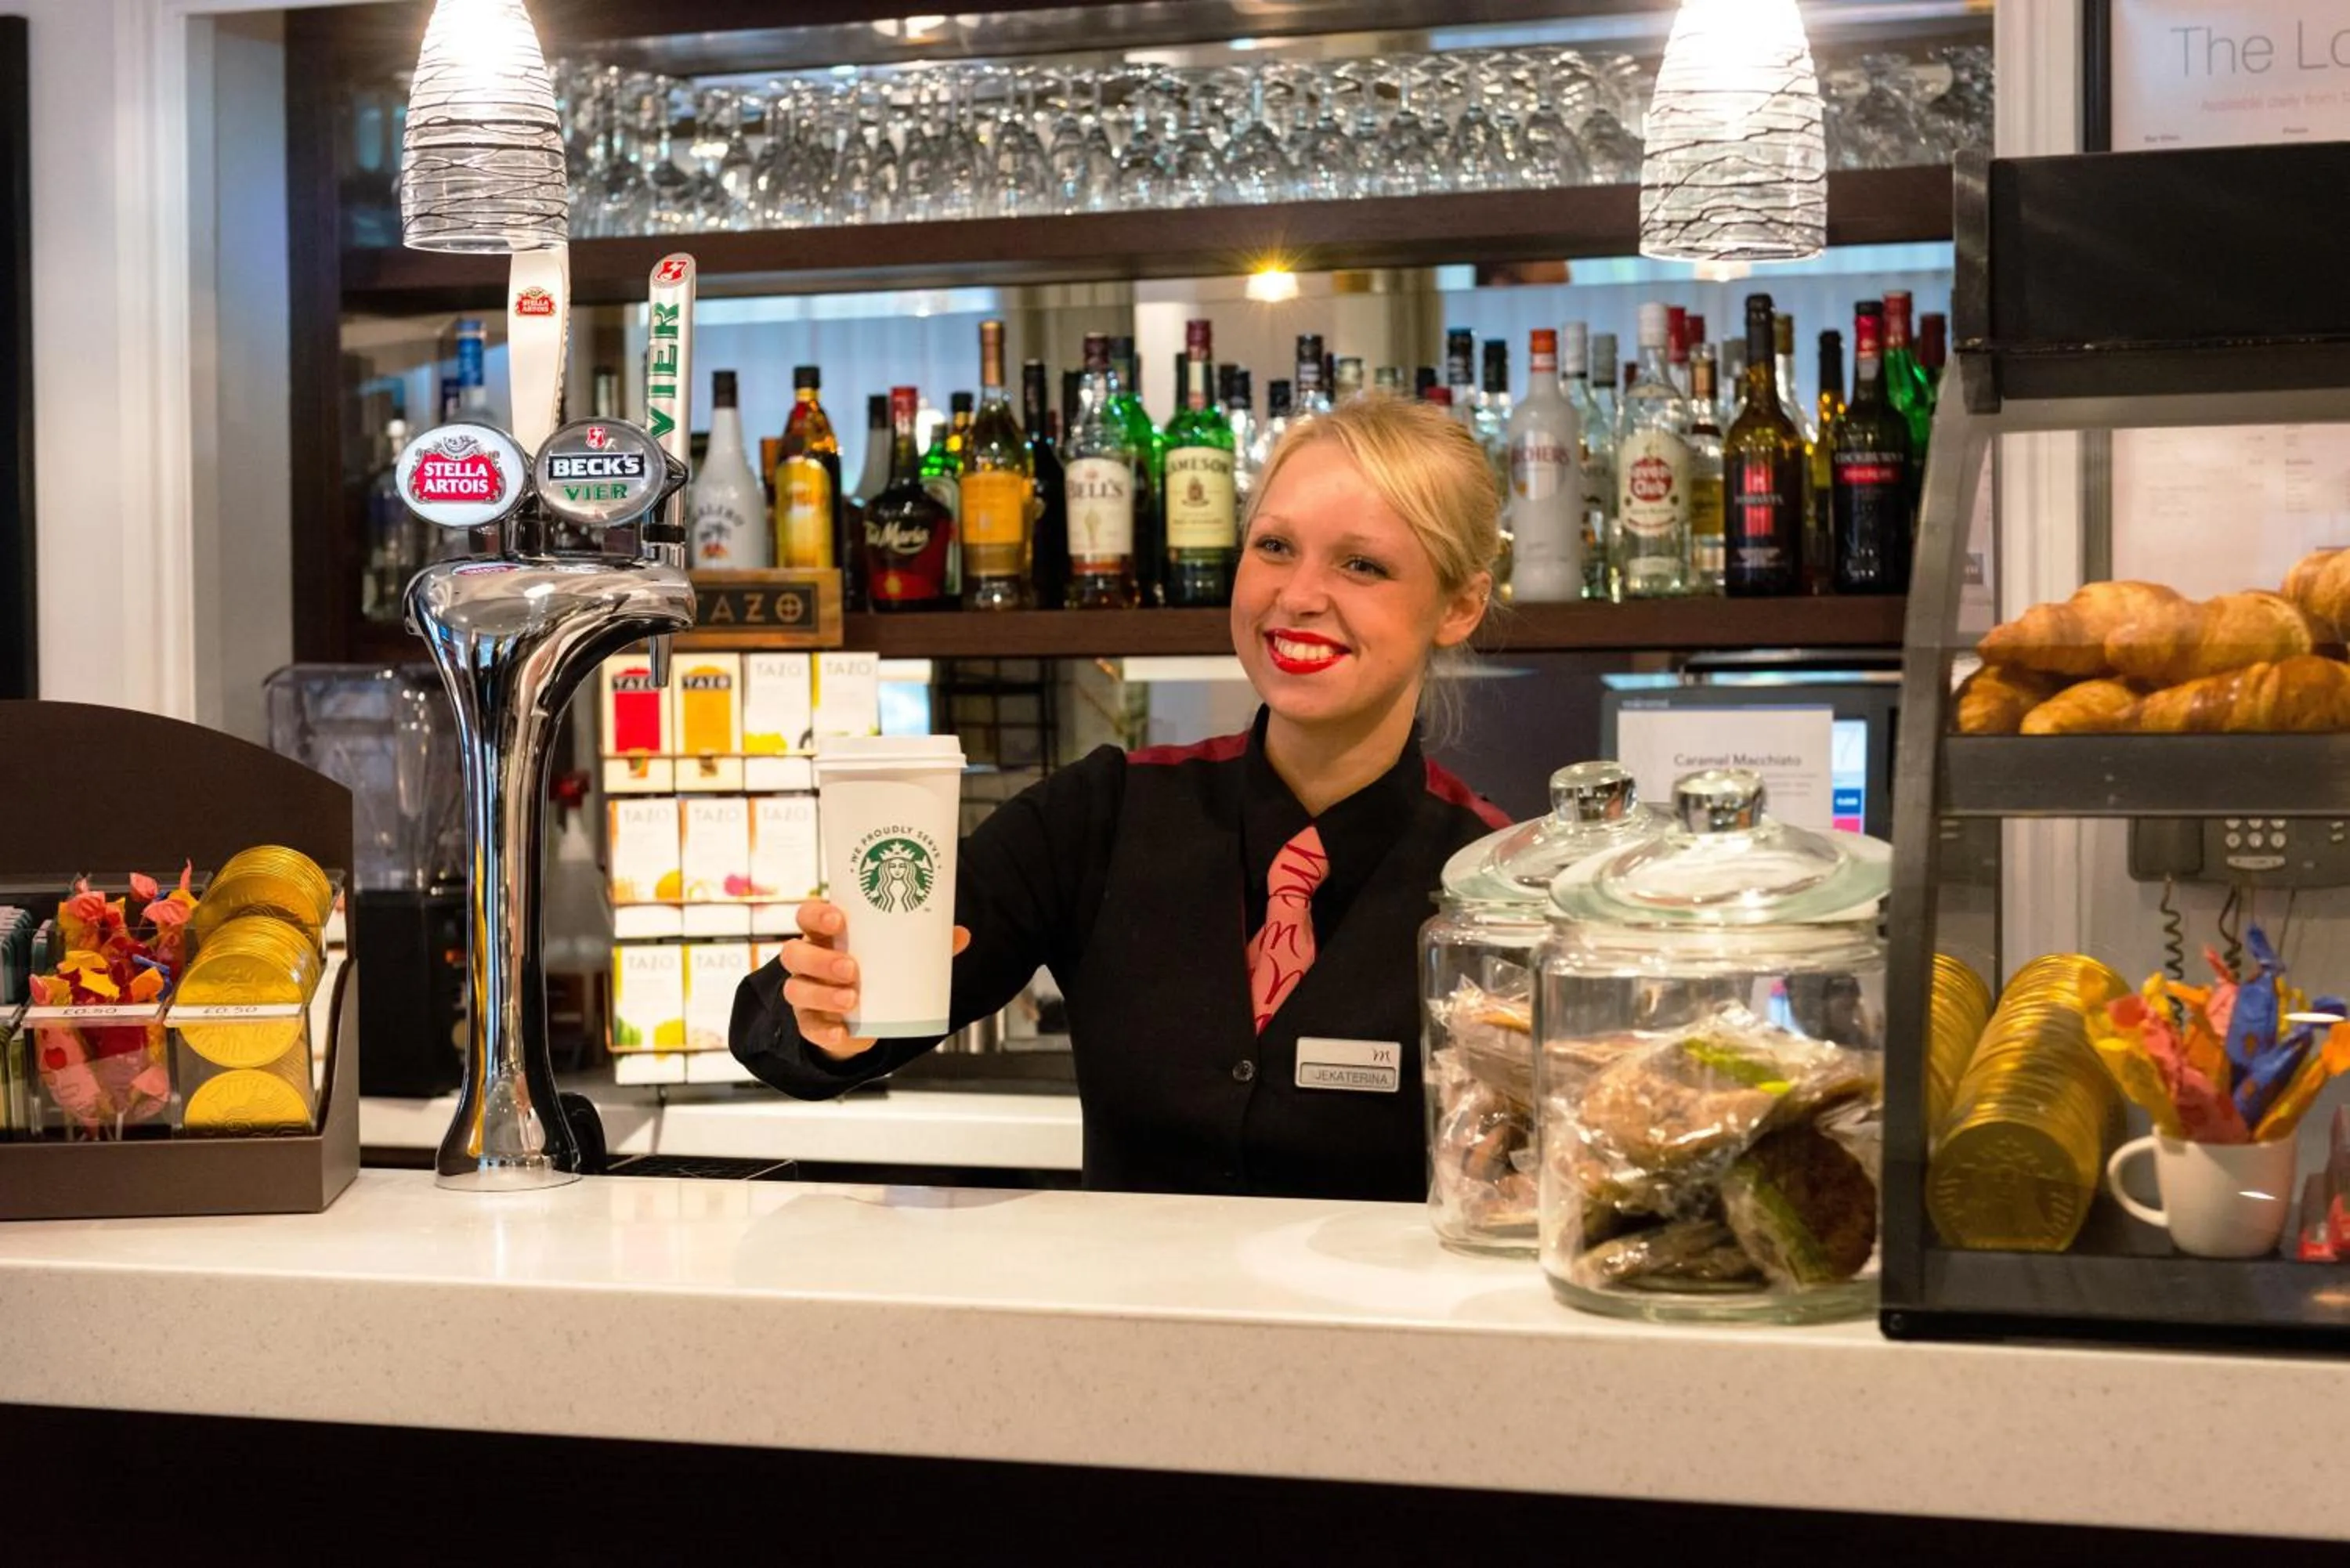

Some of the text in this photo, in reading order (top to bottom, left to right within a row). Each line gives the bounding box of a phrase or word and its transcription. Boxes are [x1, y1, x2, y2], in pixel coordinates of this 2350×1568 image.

[2169, 24, 2275, 77] The
[647, 302, 680, 439] VIER
[423, 461, 488, 477] STELLA
[551, 453, 641, 478] BECK'S
[1168, 457, 1229, 475] AMESON
[423, 478, 489, 493] ARTOIS
[562, 482, 628, 501] VIER
[696, 591, 804, 624] AZO
[756, 661, 801, 677] TAZO
[824, 659, 873, 676] TAZO
[1673, 753, 1802, 766] Caramel Macchiato
[850, 825, 942, 863] WE PROUDLY SERVE
[1314, 1069, 1388, 1085] JEKATERINA
